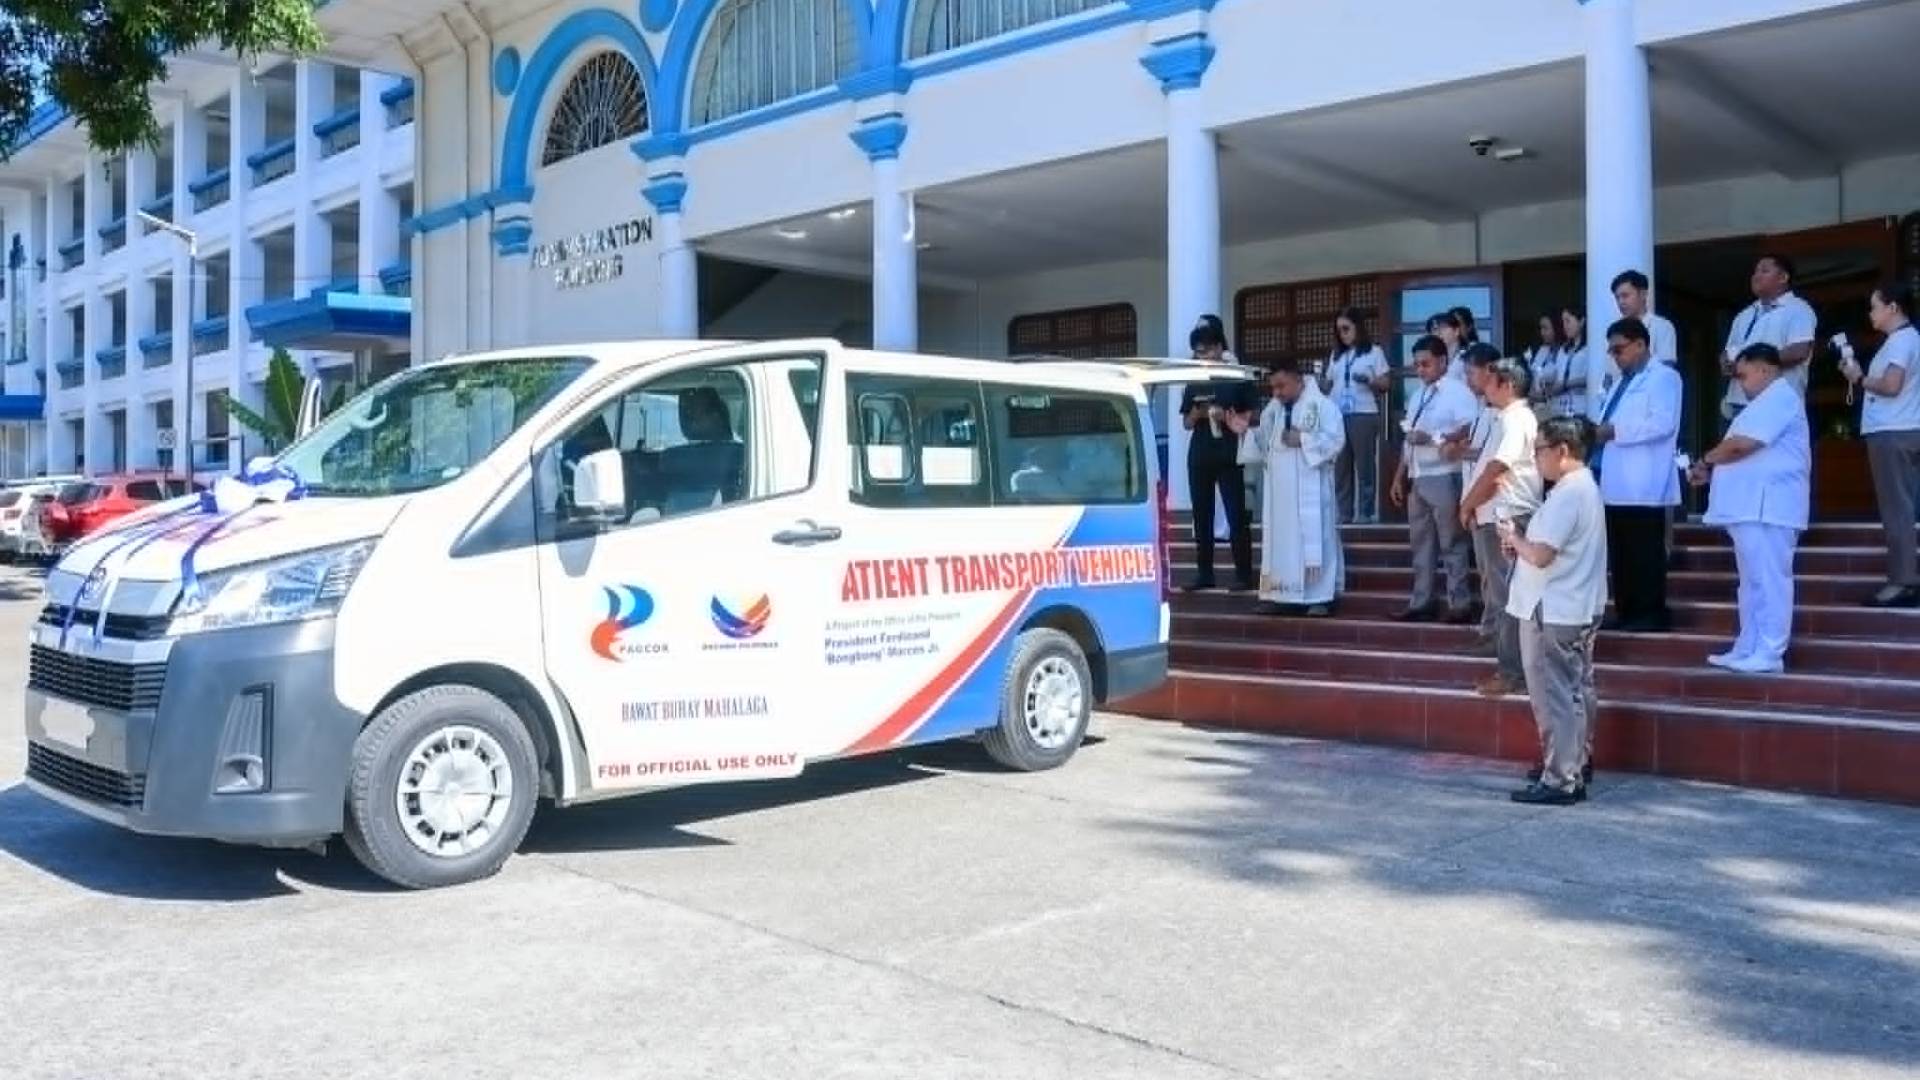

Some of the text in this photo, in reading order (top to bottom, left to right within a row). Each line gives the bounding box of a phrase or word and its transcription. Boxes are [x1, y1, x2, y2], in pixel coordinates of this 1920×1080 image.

[842, 547, 1155, 602] ATIENT TRANSPORT VEHICLE
[704, 696, 768, 718] MAHALAGA
[598, 752, 797, 779] FOR OFFICIAL USE ONLY
